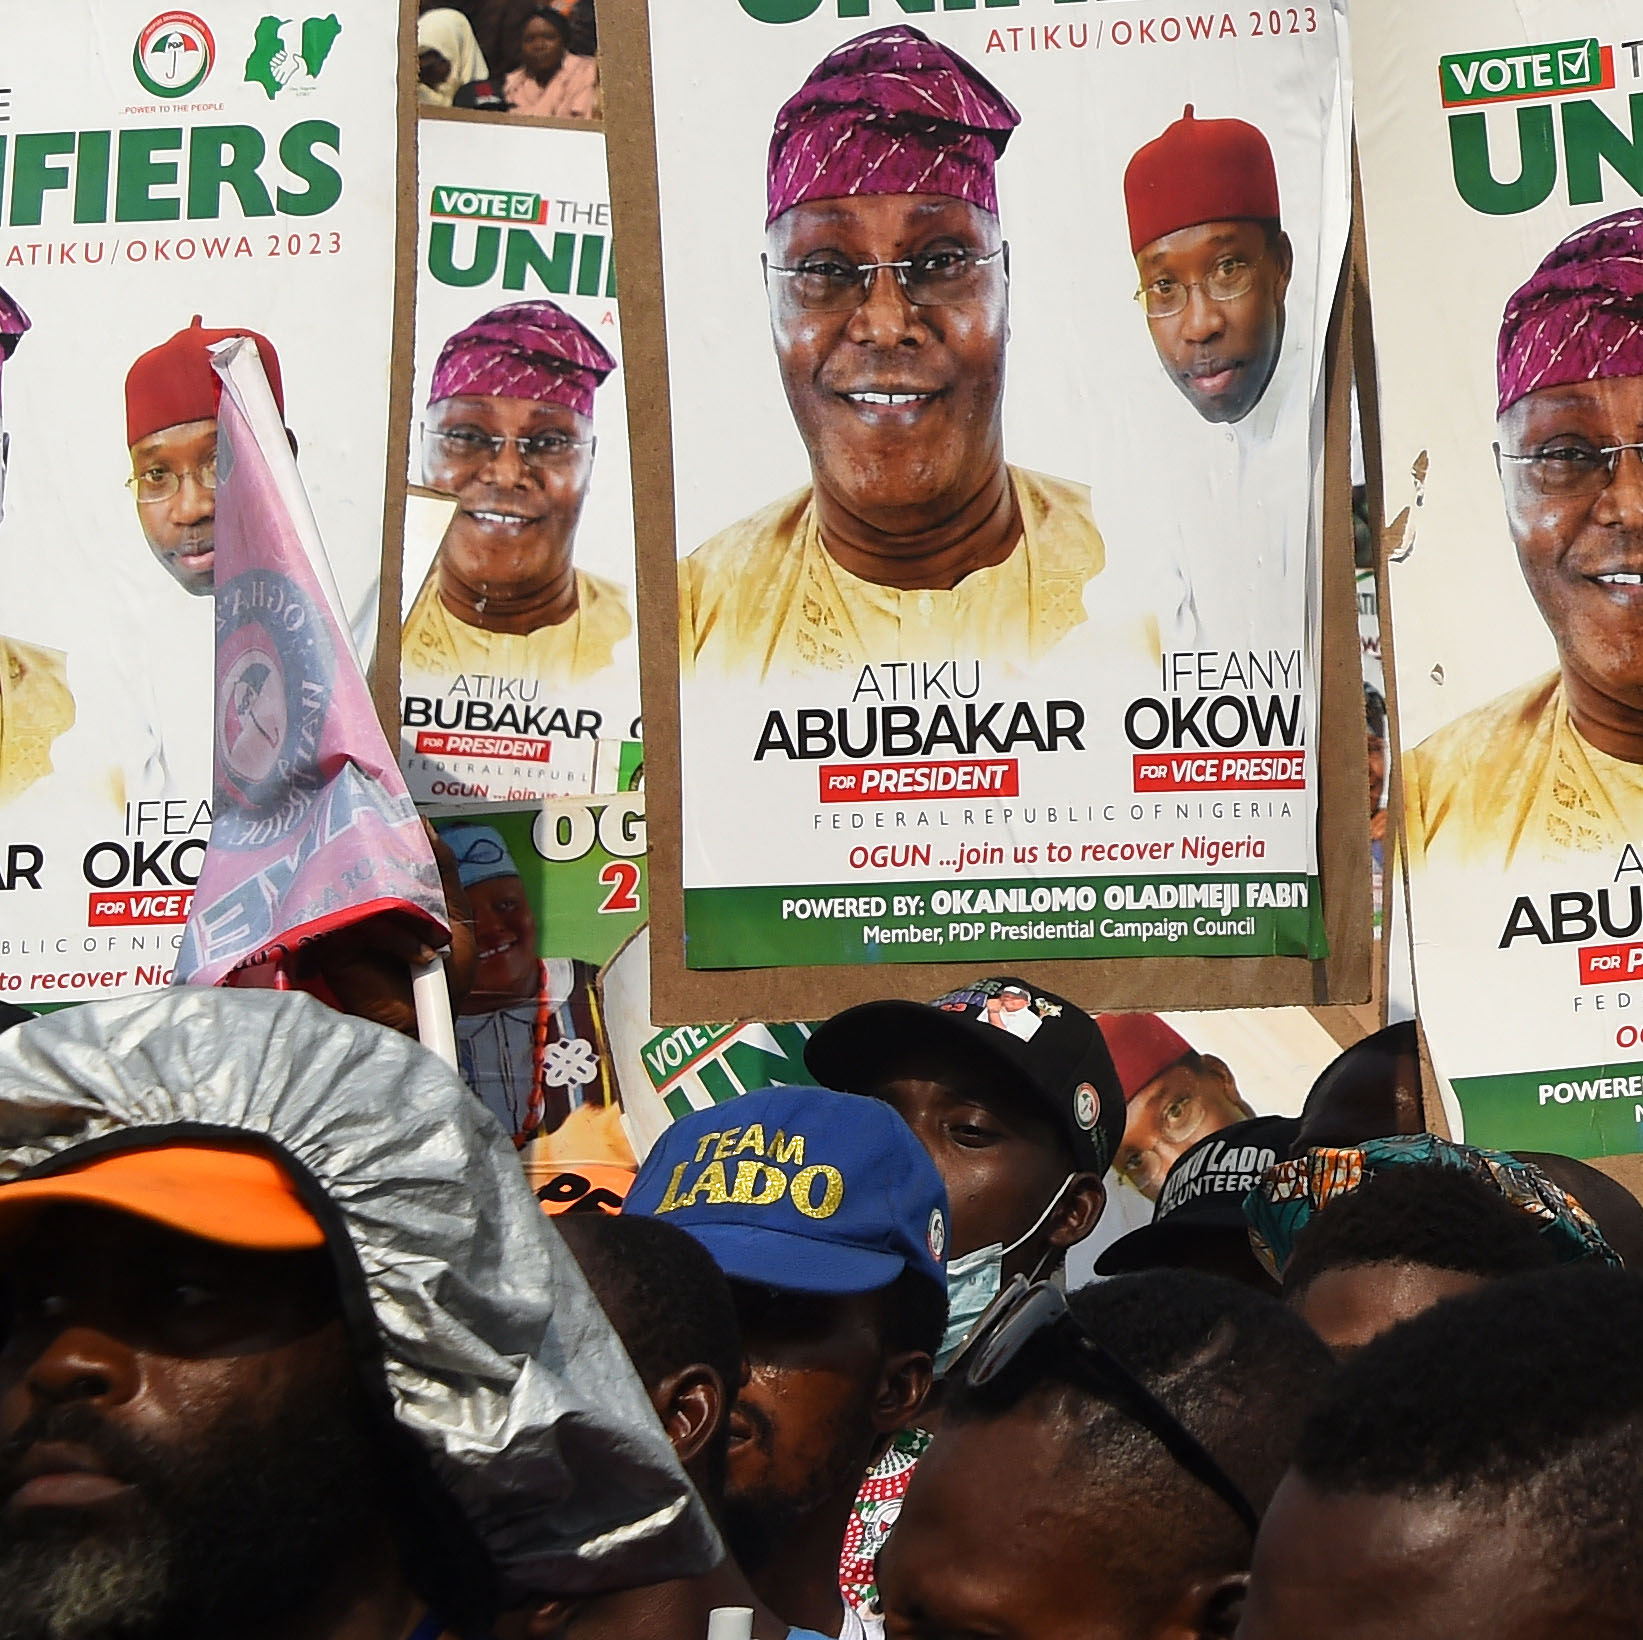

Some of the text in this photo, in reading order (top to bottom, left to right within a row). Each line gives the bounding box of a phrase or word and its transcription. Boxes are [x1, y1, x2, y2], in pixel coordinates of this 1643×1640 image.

[986, 8, 1316, 53] ATIKU/OKOWA 2023
[1451, 53, 1553, 94] VOTE
[6, 232, 340, 266] ATIKU/OKOWA 2023
[853, 650, 1301, 702] ATIKU IFEANYI
[400, 693, 603, 740] BUBAKAR
[754, 695, 1305, 761] ABUBAKAR OKOW
[829, 756, 1305, 795] FOR PRESIDENT FOR VICE PRESIDE
[815, 803, 1291, 829] FEDERAL REPUBLIC OF NIGERIA
[83, 839, 207, 888] OKO
[850, 835, 1264, 872] OGUN ...join us to recover Nigeria
[783, 897, 886, 919] POWERED
[893, 896, 924, 916] BY:
[929, 885, 1098, 917] OKANLOMO
[1103, 883, 1240, 916] OLADIMEJI
[864, 917, 1254, 944] Member, PDP Presidential Campaign Council
[1590, 956, 1621, 970] FOR
[646, 1022, 703, 1076] VOTE
[695, 1124, 805, 1171] TEAM
[654, 1158, 846, 1220] LADO
